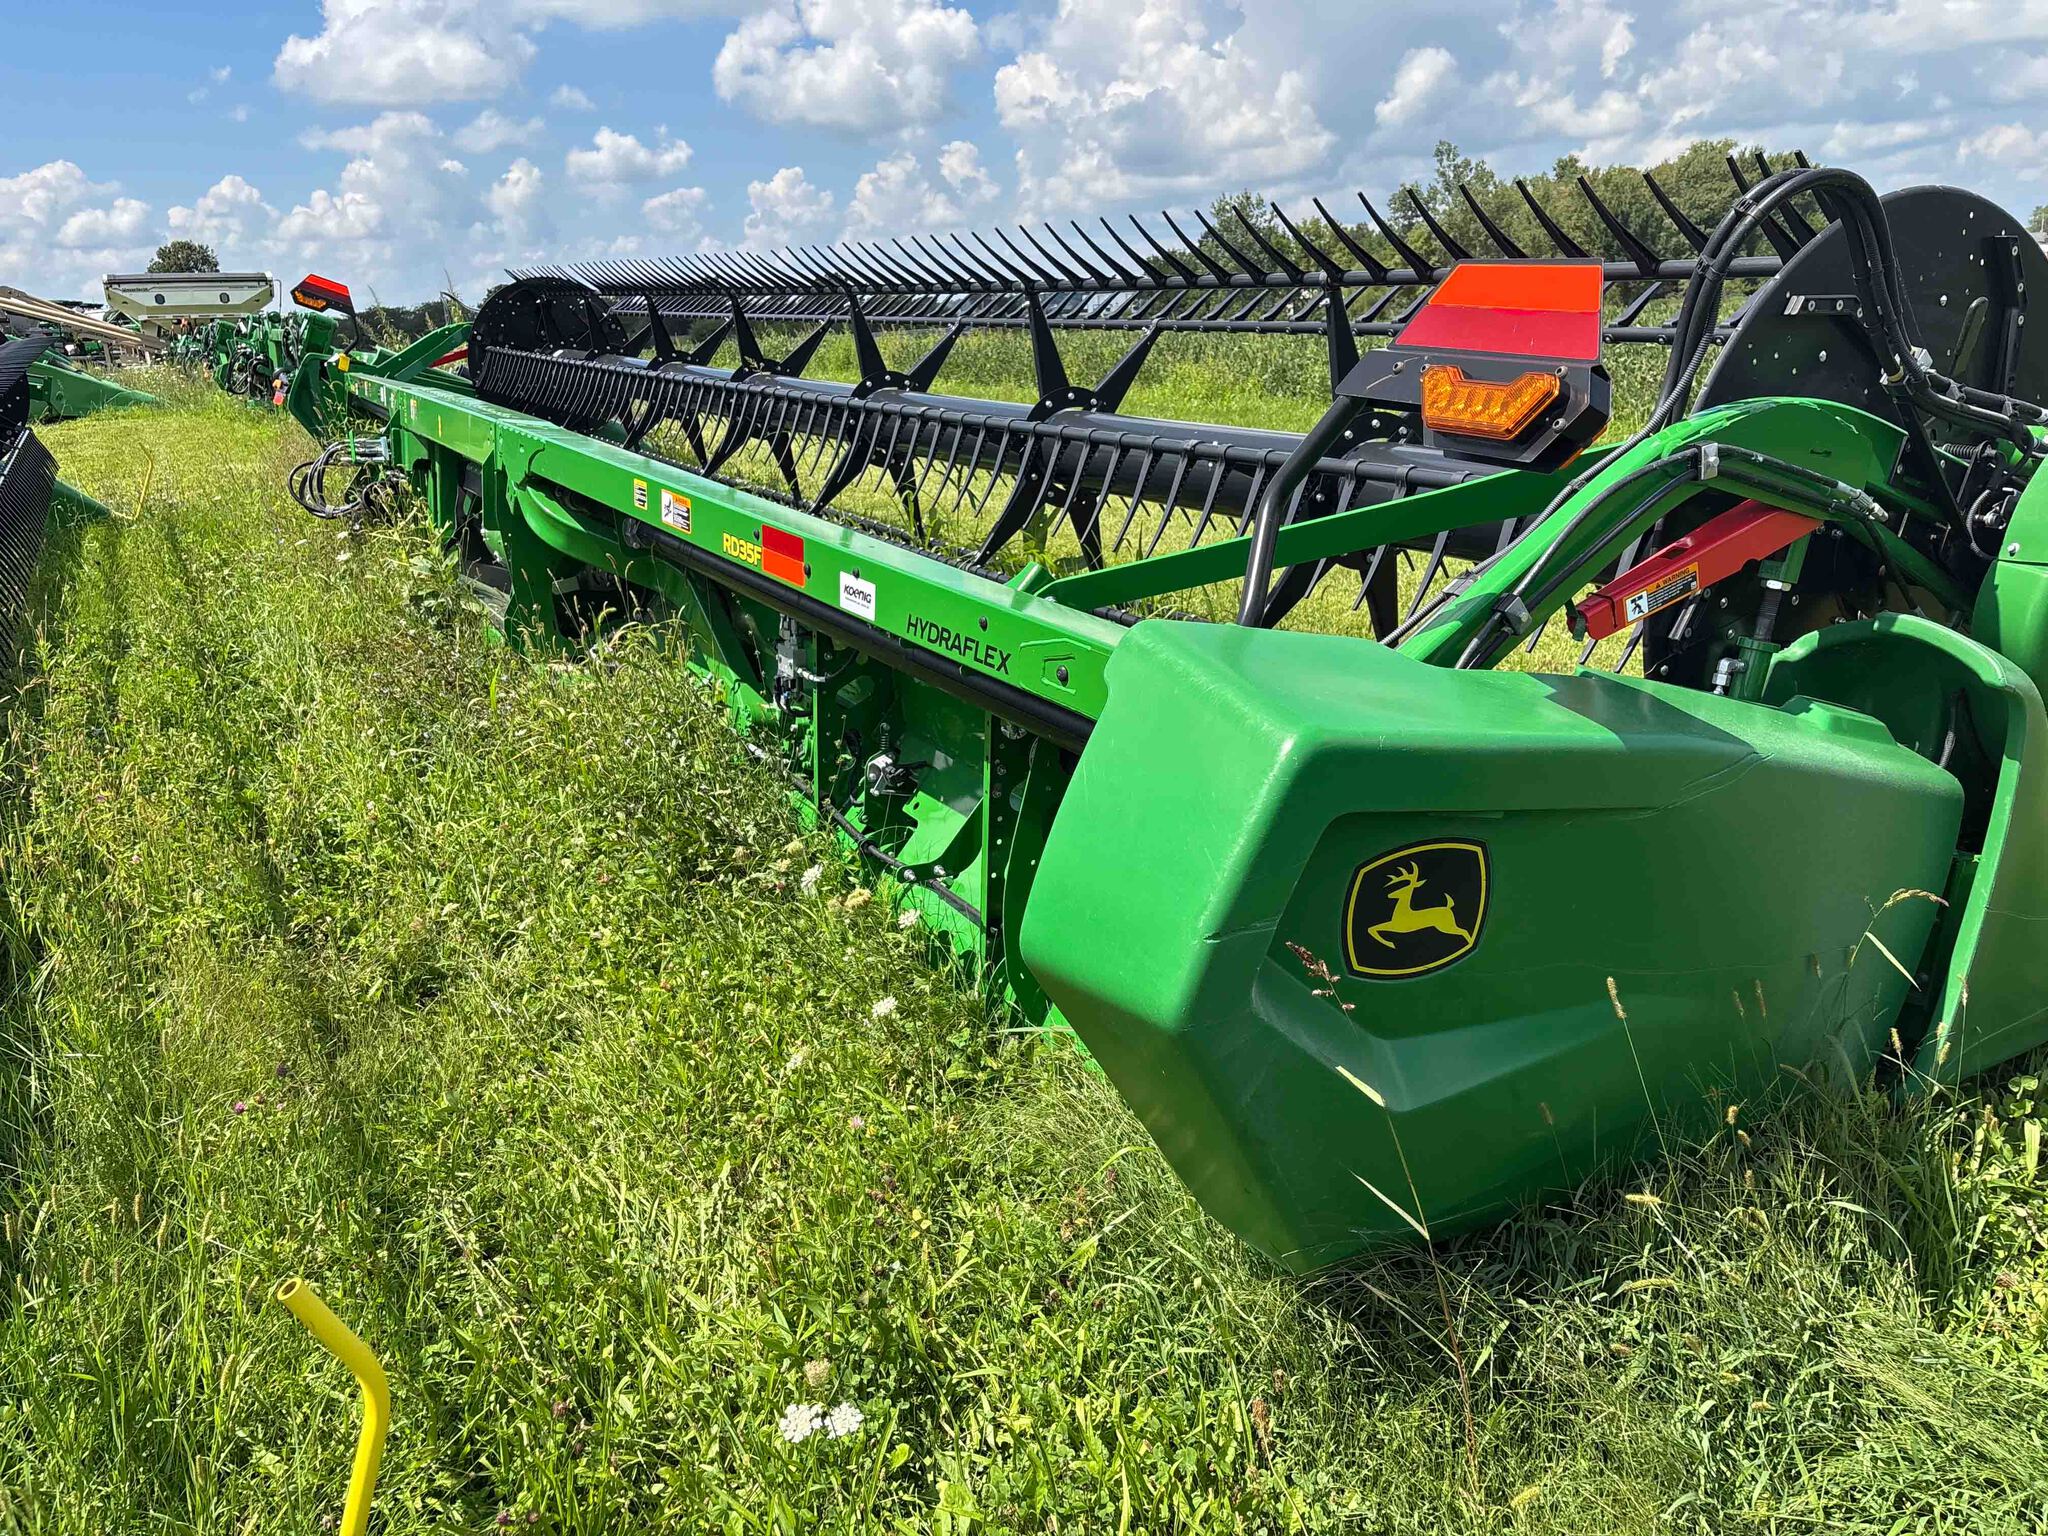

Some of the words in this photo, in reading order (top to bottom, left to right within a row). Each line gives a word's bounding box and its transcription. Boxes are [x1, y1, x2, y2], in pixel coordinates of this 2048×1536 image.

[723, 532, 762, 566] RD35F
[1663, 567, 1690, 585] WARNING
[906, 613, 1012, 676] HYDRAFLEX
